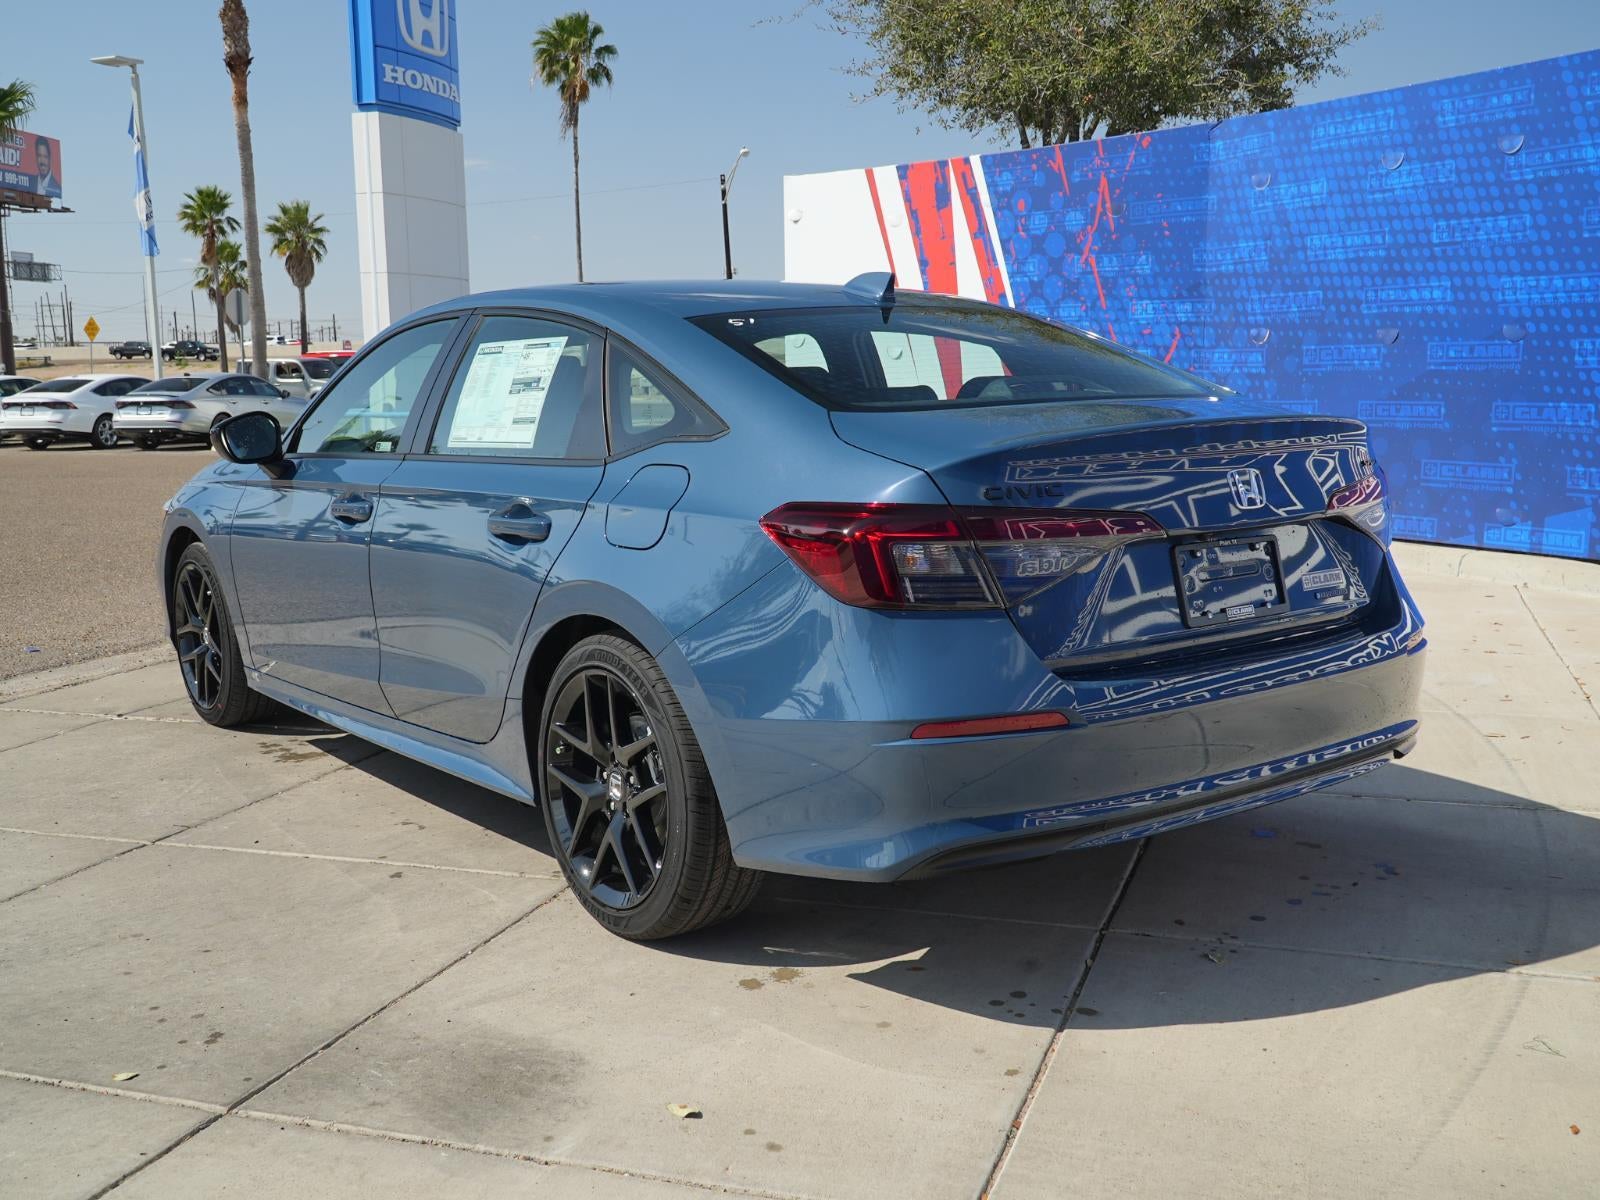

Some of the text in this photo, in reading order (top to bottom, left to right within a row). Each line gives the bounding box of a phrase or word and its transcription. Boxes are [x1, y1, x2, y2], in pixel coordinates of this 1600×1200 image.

[383, 63, 463, 104] HONDA
[1447, 342, 1518, 360] CLARK
[1514, 405, 1590, 421] CLARK
[983, 482, 1065, 501] CIVIC
[1311, 571, 1343, 585] CLARK
